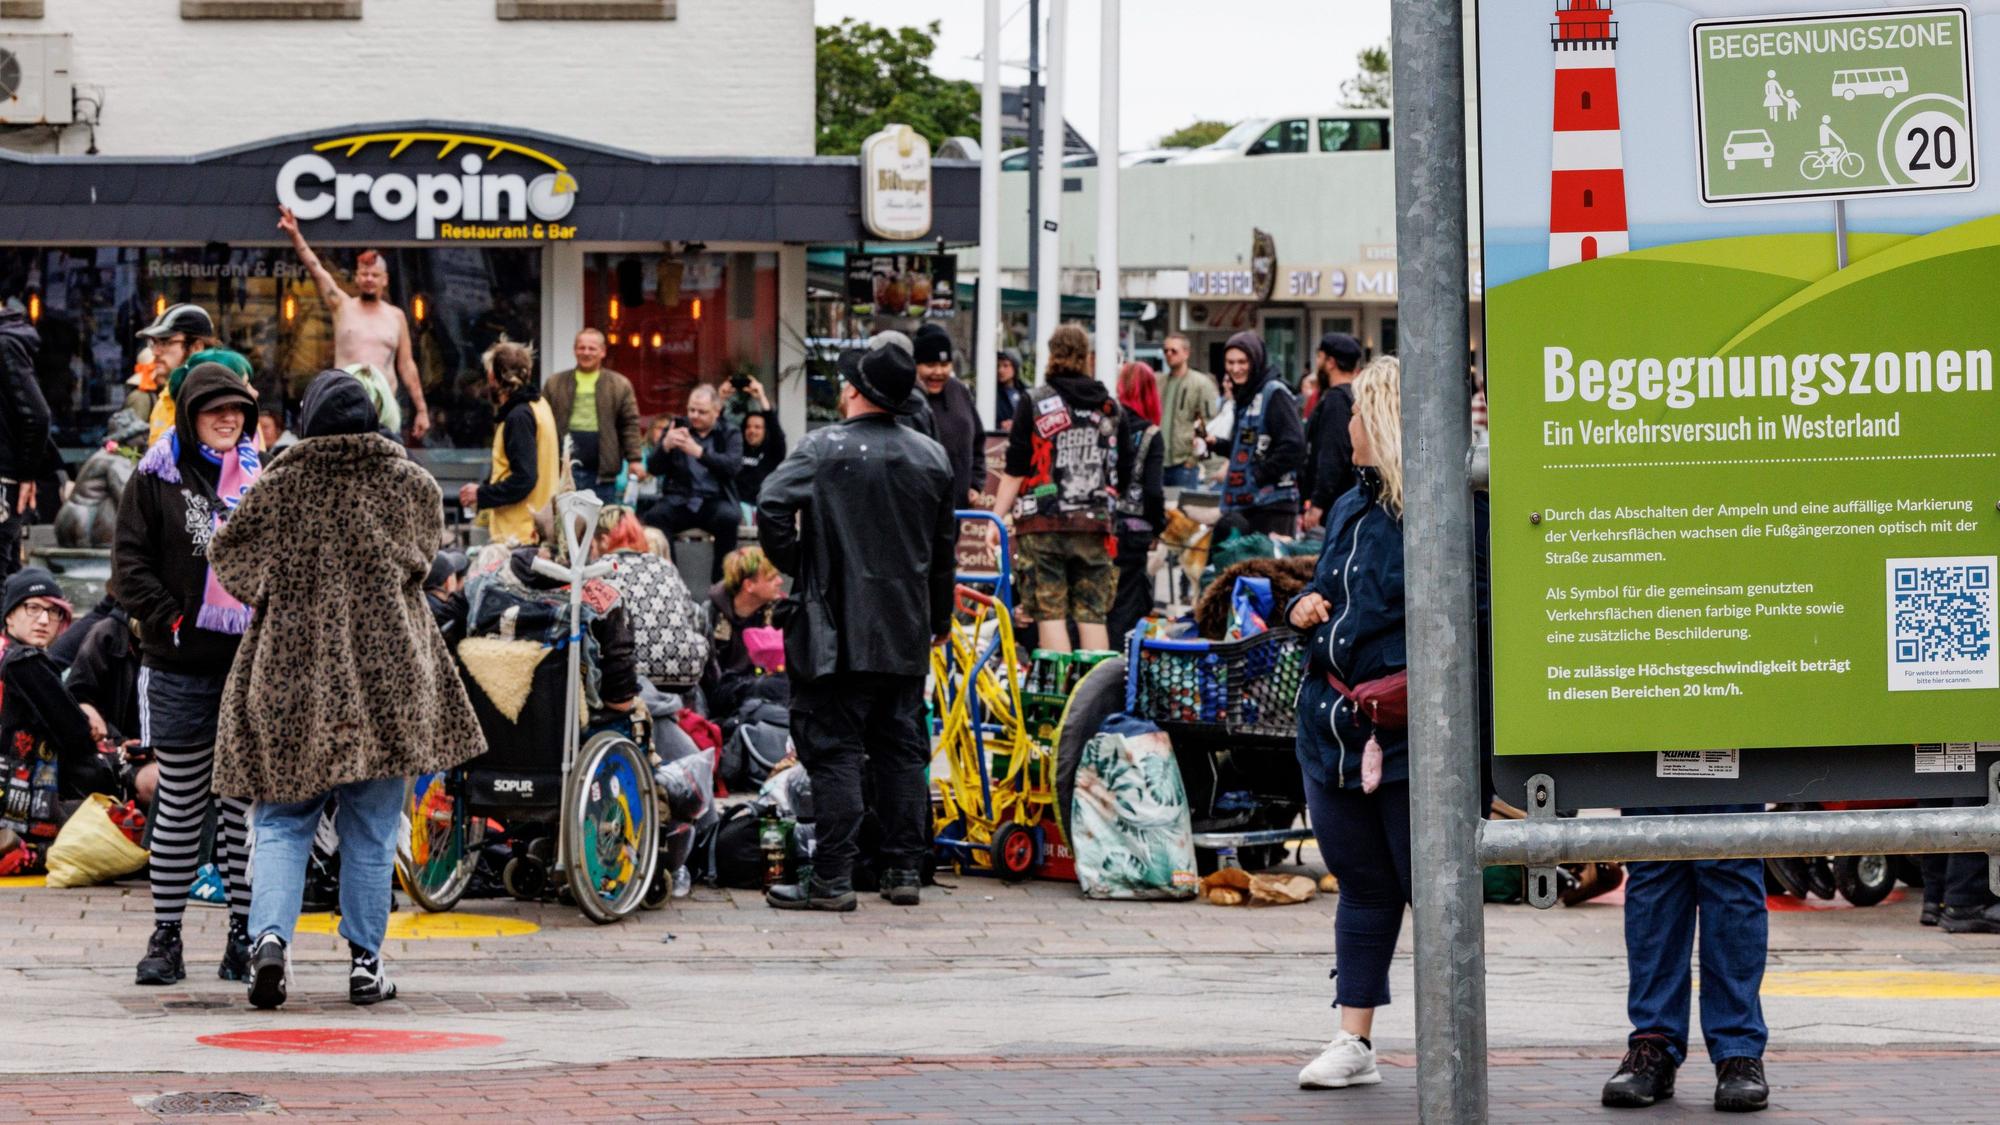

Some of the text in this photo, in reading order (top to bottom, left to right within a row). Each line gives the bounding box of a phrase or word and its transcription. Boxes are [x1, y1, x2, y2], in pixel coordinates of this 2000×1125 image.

[1709, 22, 1953, 60] BEGEGNUNGSZONE
[1908, 124, 1957, 171] 20
[276, 153, 578, 239] Cropino
[441, 223, 577, 239] Restaurant & Bar
[149, 260, 249, 277] Restaurant
[254, 260, 266, 277] &
[1543, 346, 1993, 411] Begegnungszonen
[1543, 411, 1900, 446] Ein Verkehrsversuch in Westerland
[1544, 498, 1973, 522] Durch das Abschalten der Ampeln und eine auffällige Markierung
[1544, 518, 1978, 543] der Verkehrsflächen wachsen die Fußgängerzonen optisch mit der
[1545, 550, 1666, 565] Straße zusammen.
[1545, 582, 1814, 602] Als Symbol für die gemeinsam genutzten
[1545, 601, 1845, 622] Verkehrsflächen dienen farbige Punkte sowie
[1546, 626, 1752, 644] eine zusätzliche Beschilderung.
[1547, 658, 1851, 680] Die zulässige Höchstgeschwindigkeit beträgt
[1916, 669, 1939, 677] weitere
[1940, 668, 1984, 676] Informationen
[1916, 677, 1932, 685] bitte
[1547, 682, 1744, 701] in diesen Bereichen 20 km/h.
[493, 779, 534, 792] SOPUR
